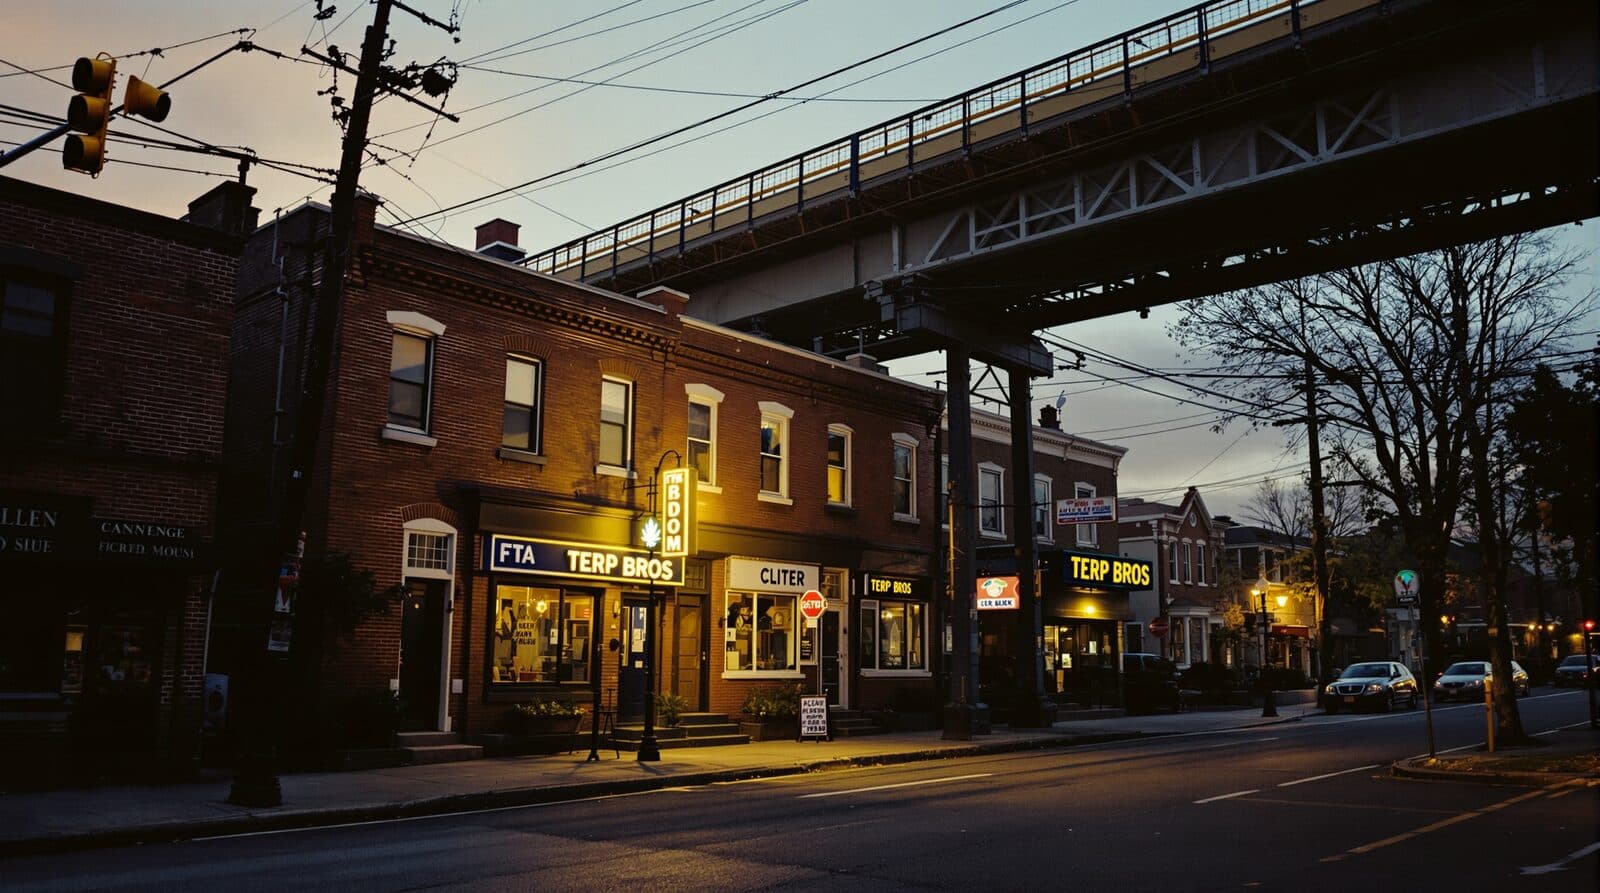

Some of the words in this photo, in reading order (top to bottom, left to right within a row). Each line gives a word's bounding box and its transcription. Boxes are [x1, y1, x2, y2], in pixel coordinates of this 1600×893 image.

[499, 542, 536, 565] FTA
[567, 549, 618, 574] TERP
[622, 556, 674, 580] BROS
[760, 568, 805, 587] CLITER
[1071, 556, 1110, 581] TERP
[1113, 561, 1150, 586] BROS
[871, 578, 891, 593] TERP
[893, 581, 911, 594] BROS
